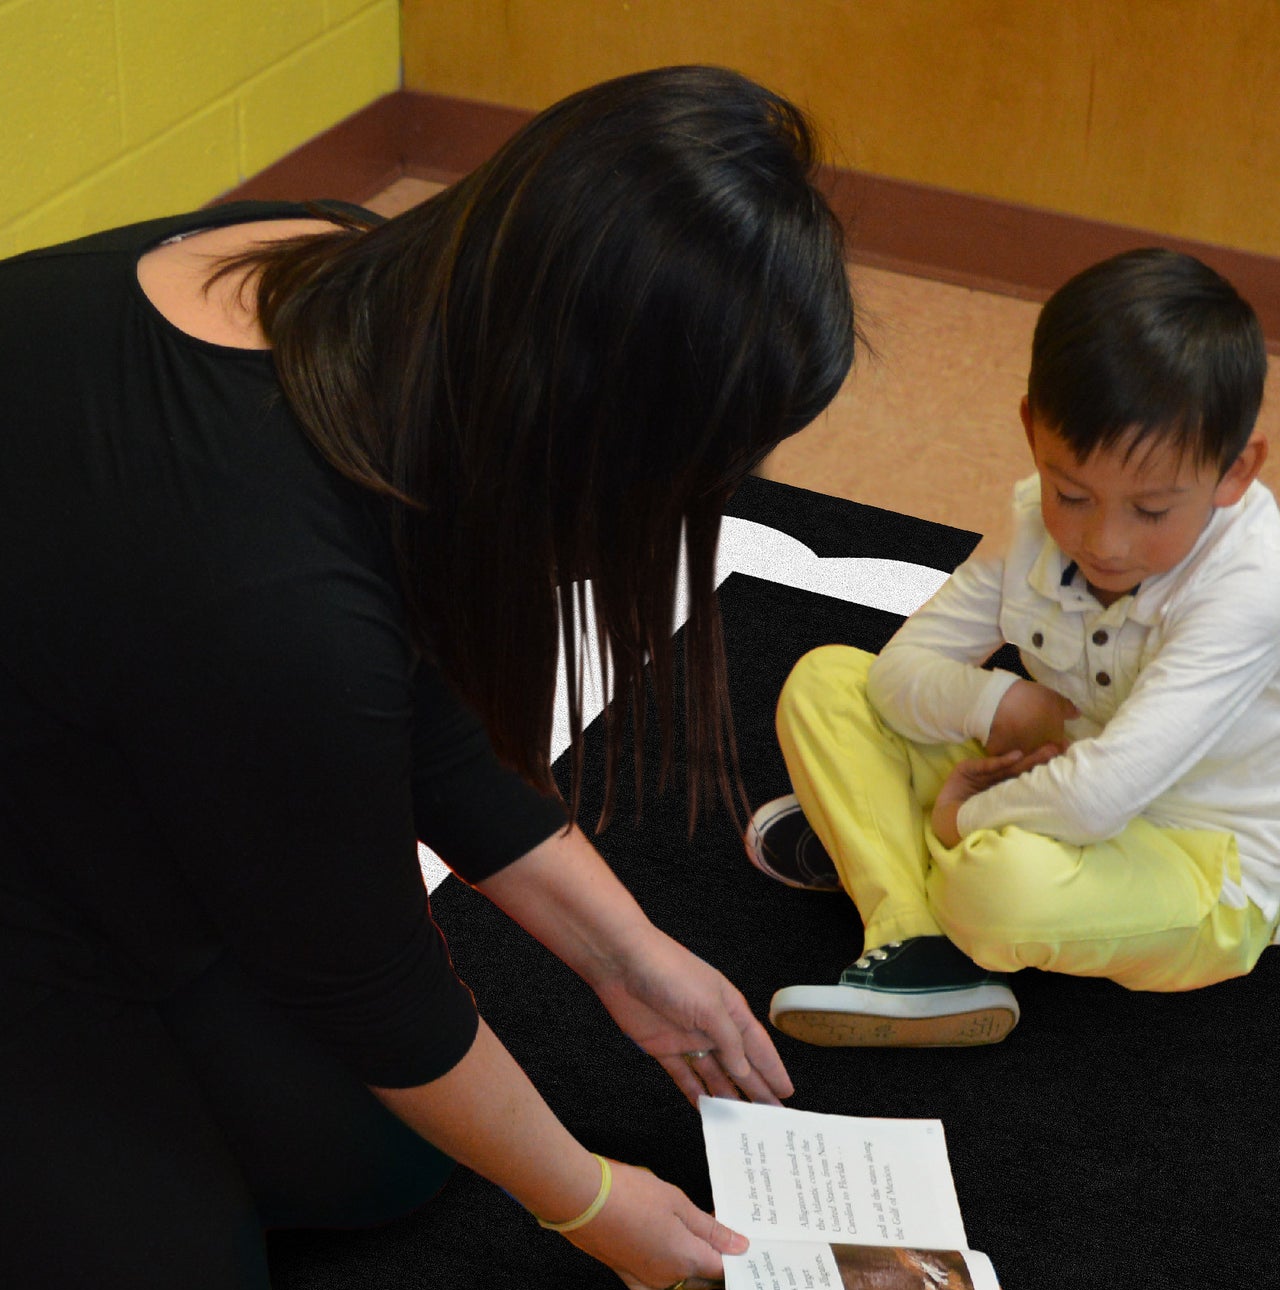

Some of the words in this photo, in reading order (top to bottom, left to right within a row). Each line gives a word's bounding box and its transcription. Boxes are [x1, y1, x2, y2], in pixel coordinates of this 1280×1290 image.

[801, 1138, 811, 1152] the
[815, 1132, 826, 1156] North
[835, 1161, 849, 1190] Florida
[870, 1187, 881, 1201] the
[815, 1217, 826, 1231] the
[828, 1205, 841, 1232] United
[844, 1202, 857, 1235] Carolina
[889, 1205, 901, 1226] Gulf
[876, 1223, 889, 1239] and
[895, 1226, 905, 1241] the
